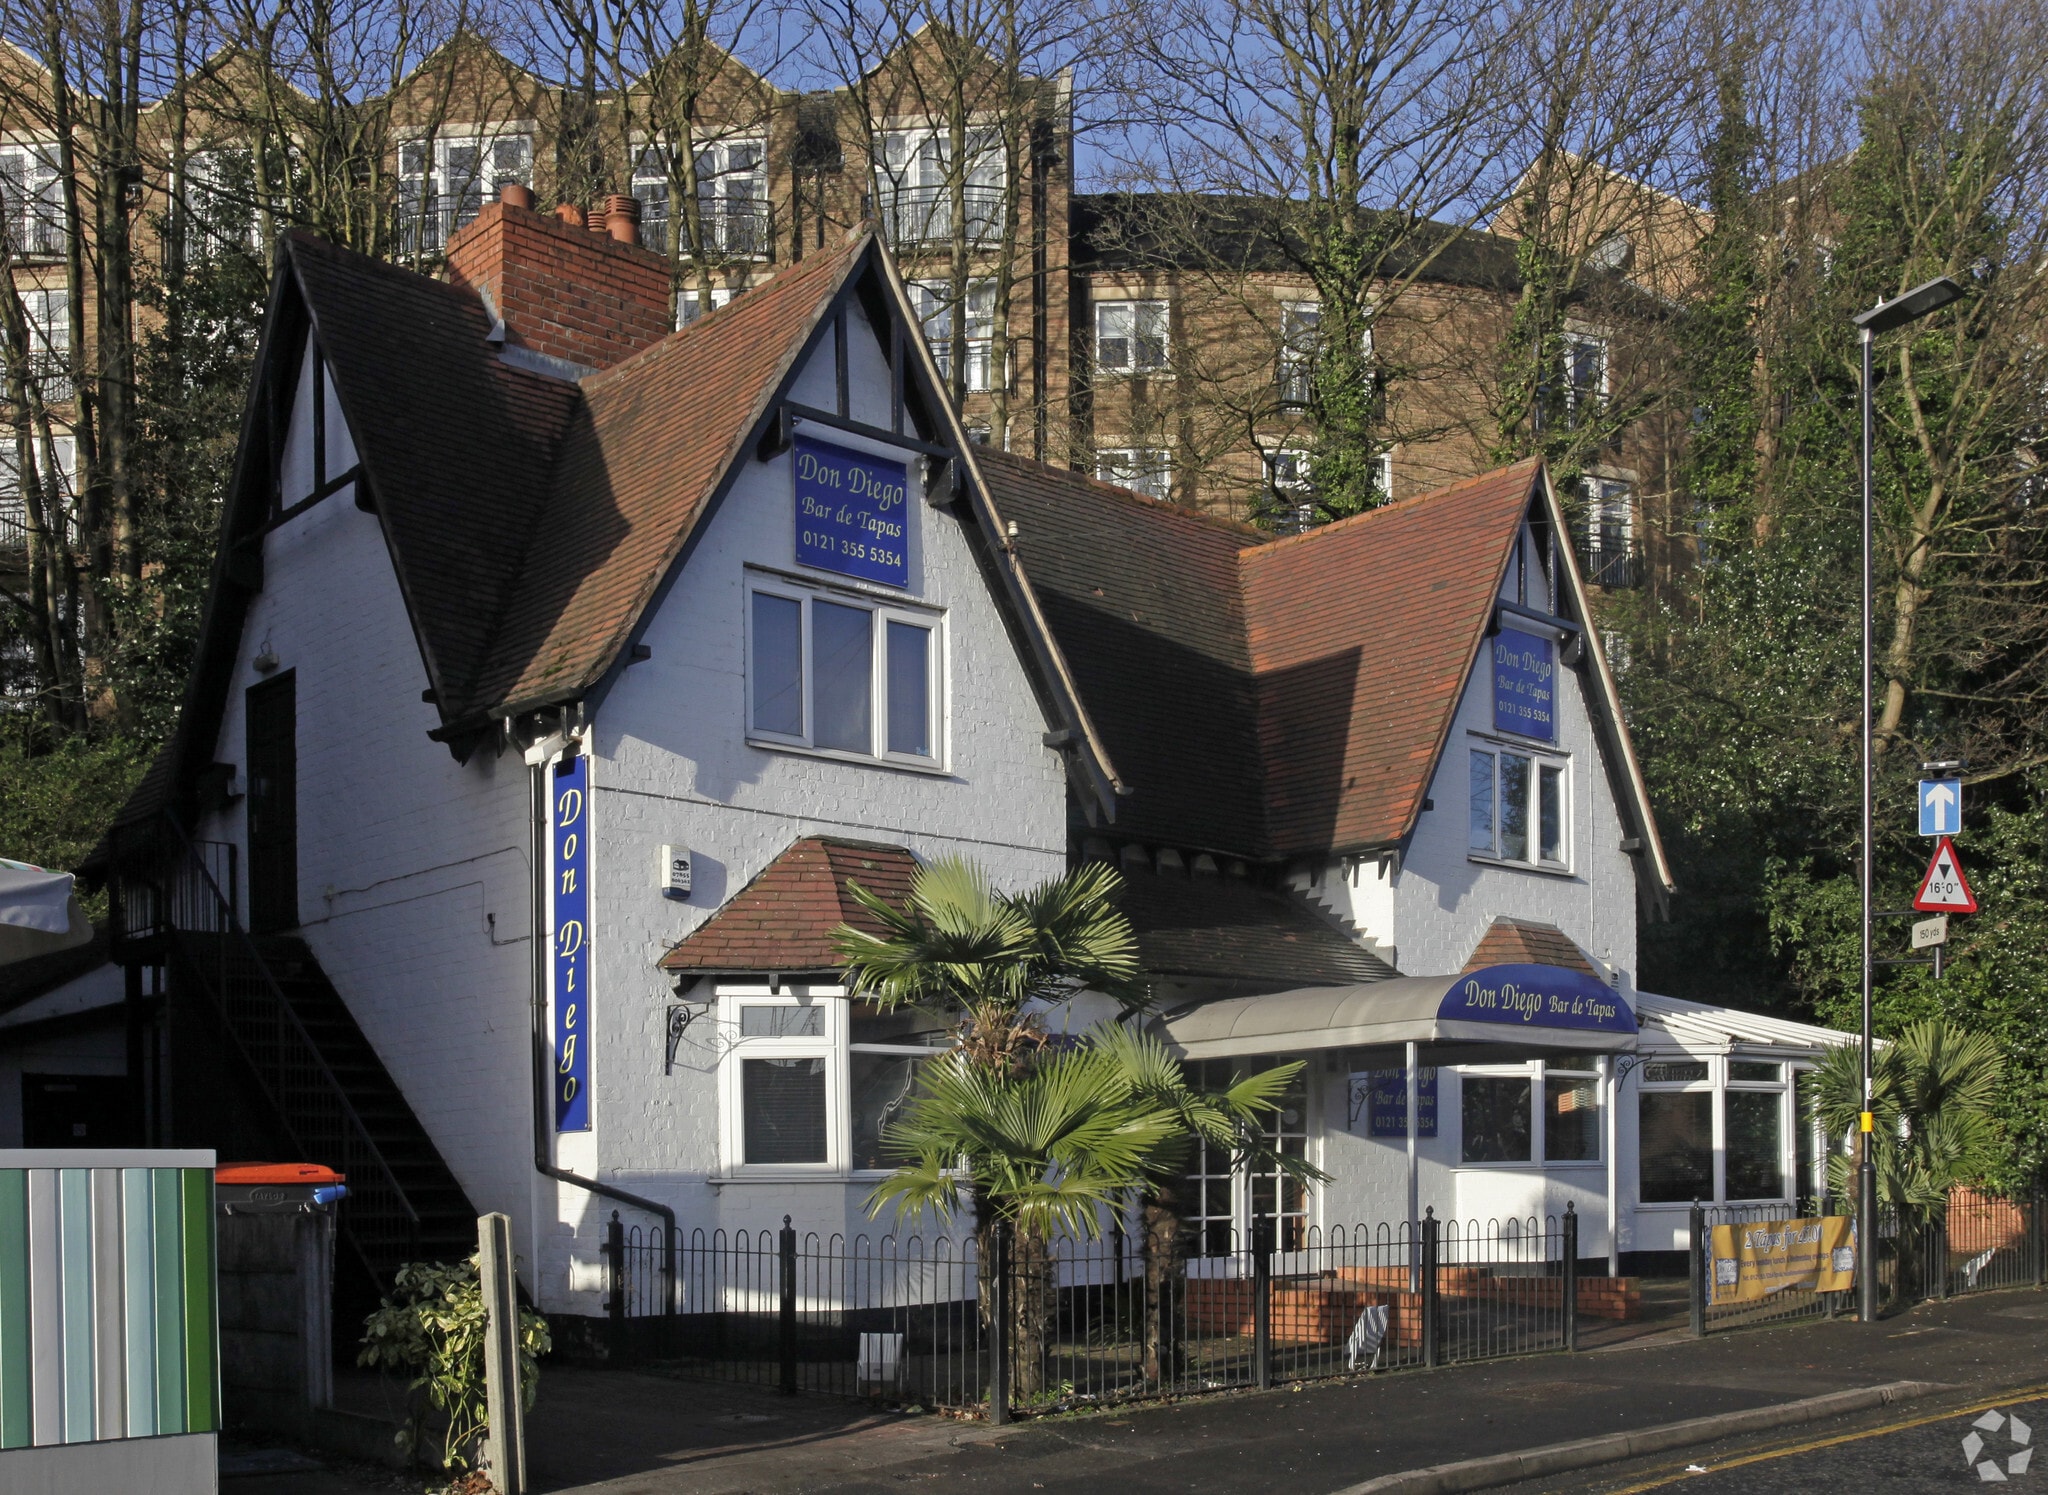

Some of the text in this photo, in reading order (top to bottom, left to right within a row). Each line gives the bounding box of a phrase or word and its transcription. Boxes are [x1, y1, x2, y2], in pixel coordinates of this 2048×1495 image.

[799, 453, 903, 511] Don Diego
[802, 496, 902, 539] Bar de Tapas
[803, 530, 902, 567] 0121 355 5354
[1496, 644, 1551, 682] Don Diego
[1497, 675, 1550, 703] Bar de Tapas
[1498, 700, 1550, 723] 0121 355 5354
[558, 788, 583, 1102] Don Diego
[1930, 926, 1940, 938] yds
[1465, 980, 1616, 1022] Don Diego Bar de Tapas
[1374, 1090, 1393, 1105] Bar
[1395, 1090, 1406, 1106] de
[1376, 1117, 1395, 1128] 0121
[1745, 1231, 1752, 1249] 2
[1754, 1228, 1781, 1253] Tapas
[1781, 1224, 1798, 1251] for
